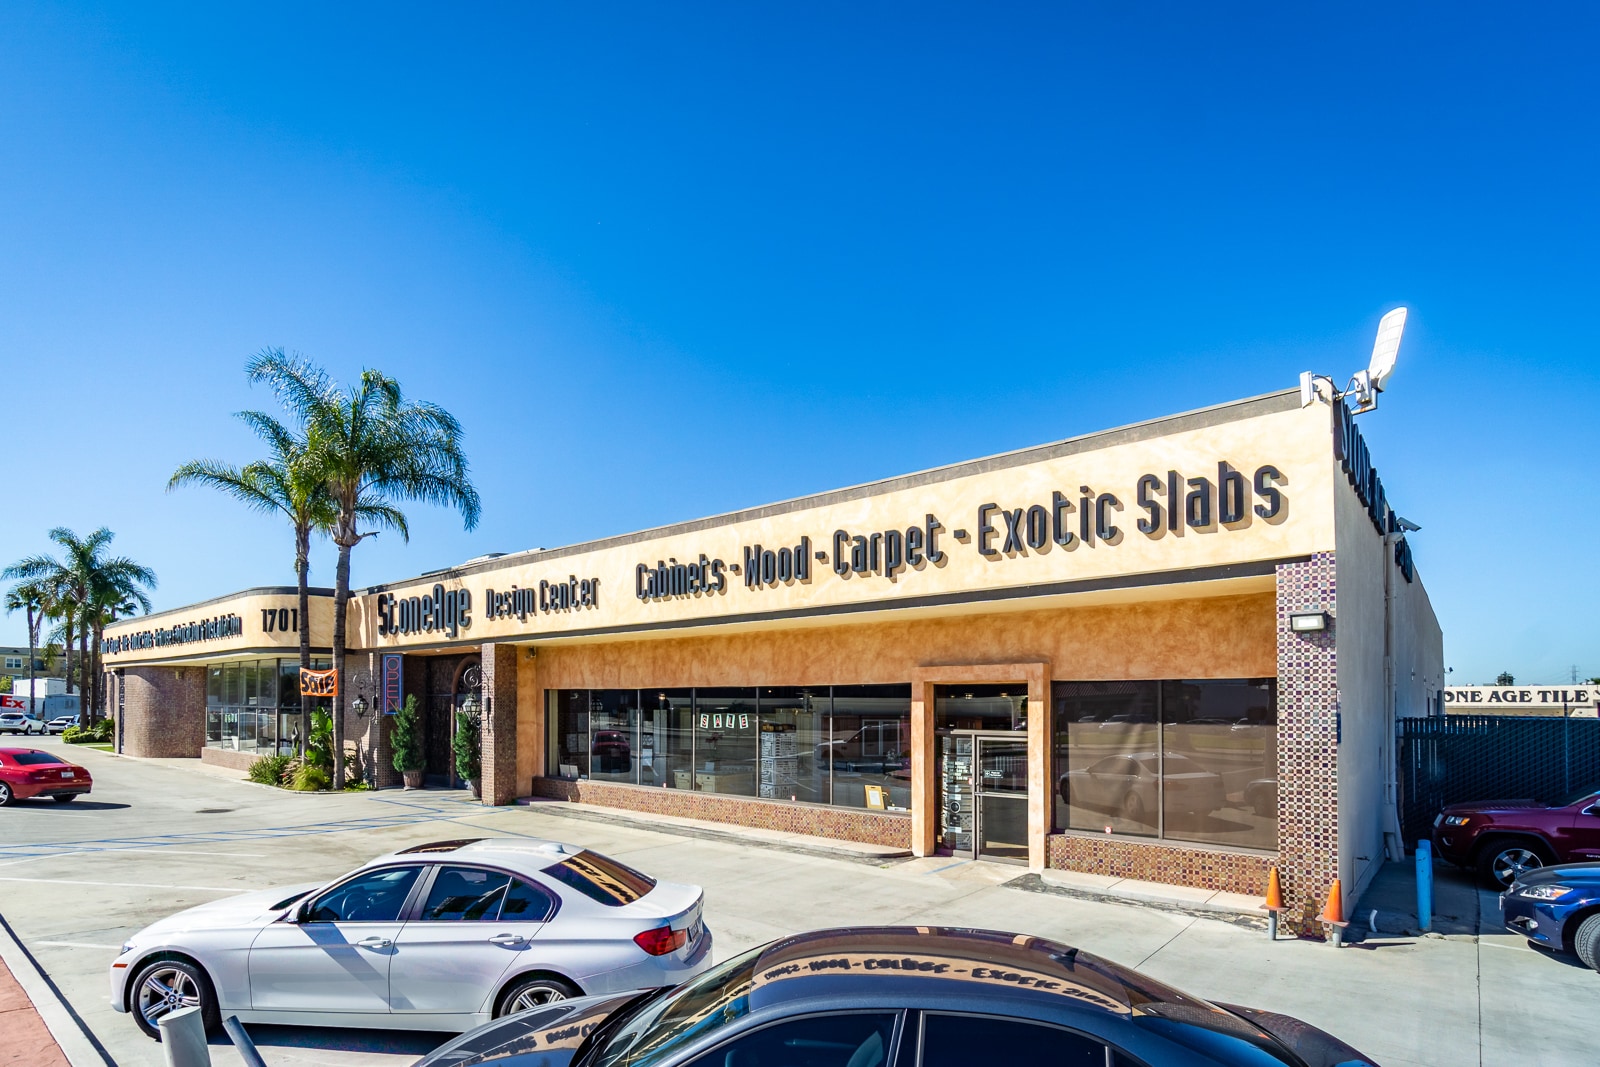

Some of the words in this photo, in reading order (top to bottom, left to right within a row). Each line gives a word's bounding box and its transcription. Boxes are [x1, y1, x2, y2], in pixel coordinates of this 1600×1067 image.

[636, 553, 725, 600] Cabinets
[744, 535, 809, 587] Wood
[833, 513, 941, 578] Carpet
[978, 485, 1118, 556] Exotic
[1137, 460, 1281, 535] Slabs
[260, 608, 298, 632] 1701
[377, 583, 471, 638] StoneAge
[486, 584, 535, 620] Design
[540, 574, 599, 612] Center
[386, 657, 399, 712] OPEN
[1487, 690, 1533, 703] AGE
[1537, 689, 1589, 703] TILE
[702, 715, 748, 728] SALE
